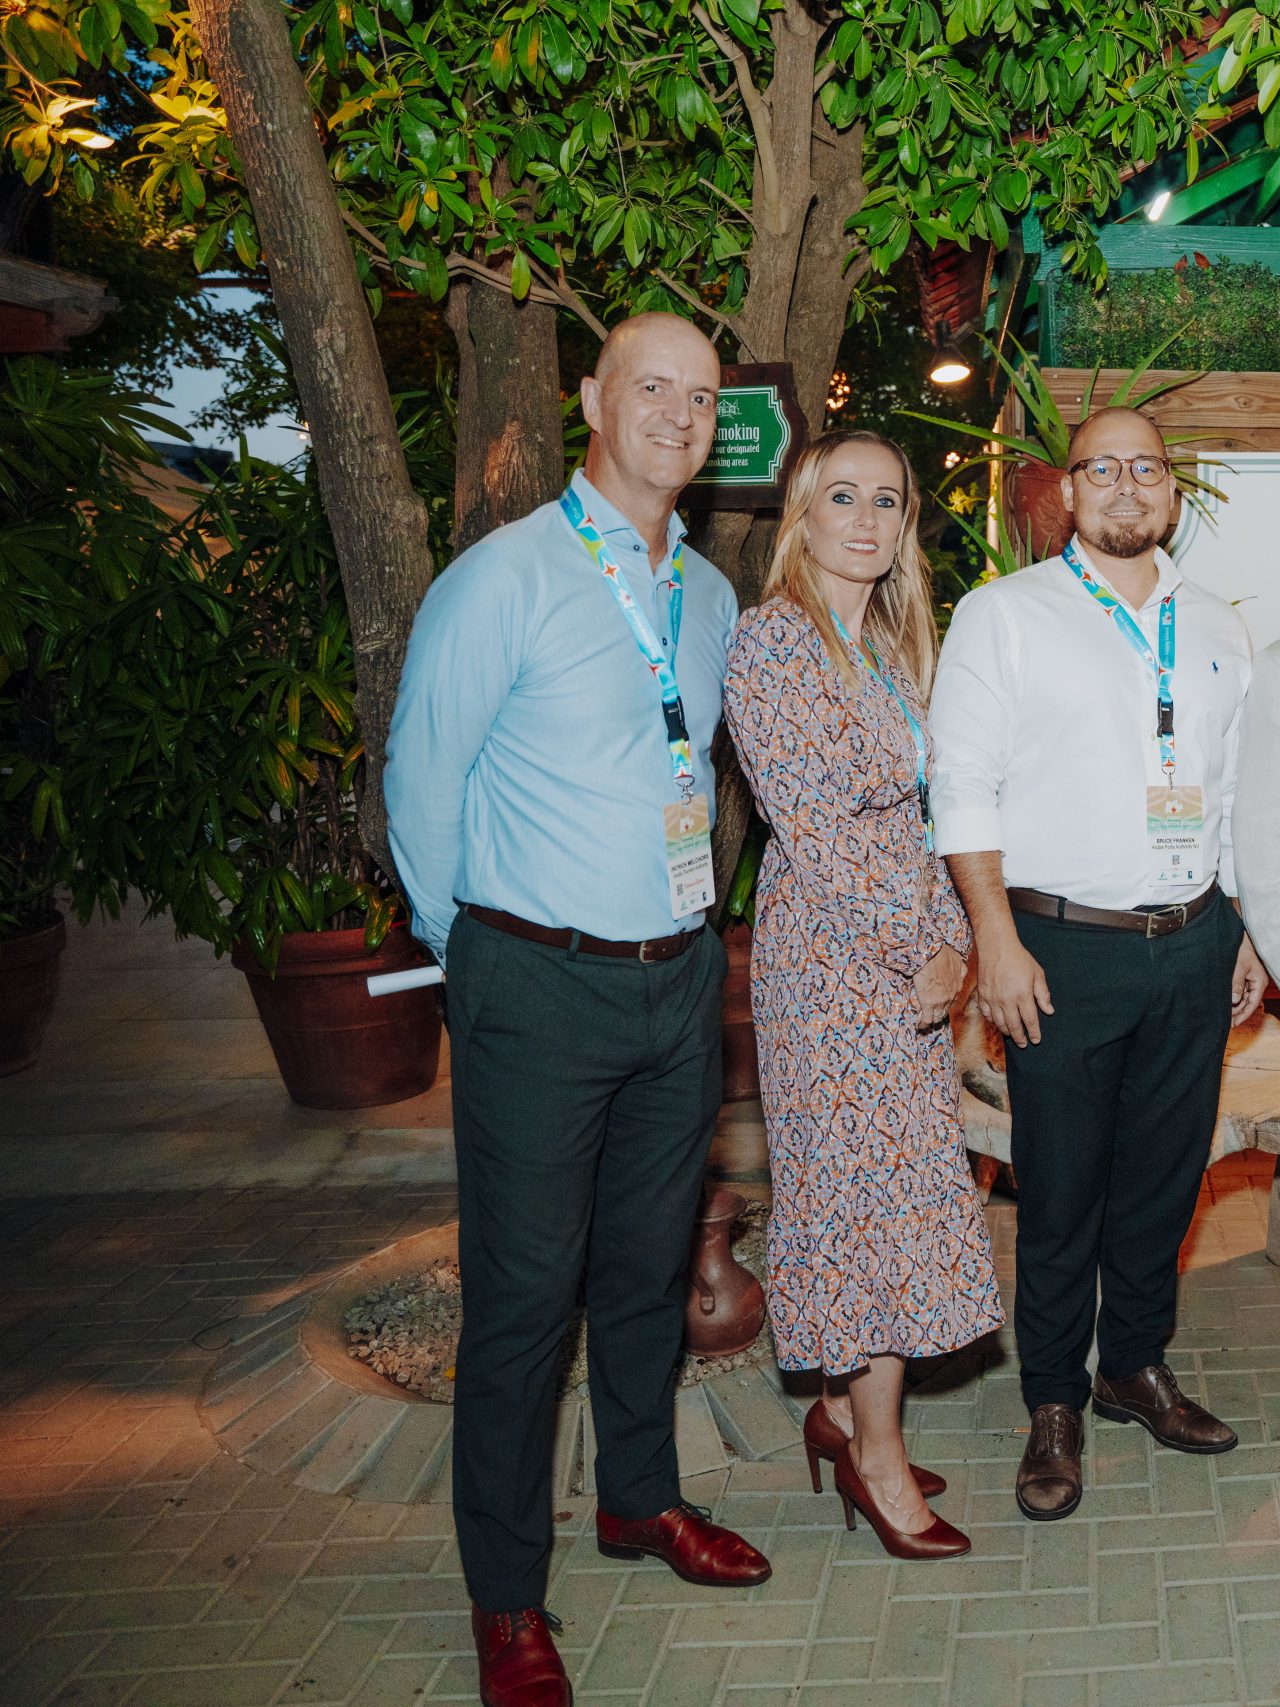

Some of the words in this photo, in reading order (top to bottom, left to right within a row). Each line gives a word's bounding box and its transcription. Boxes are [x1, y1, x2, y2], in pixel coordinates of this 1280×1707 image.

[715, 446, 726, 454] our
[726, 443, 760, 455] designated
[731, 458, 749, 467] areas
